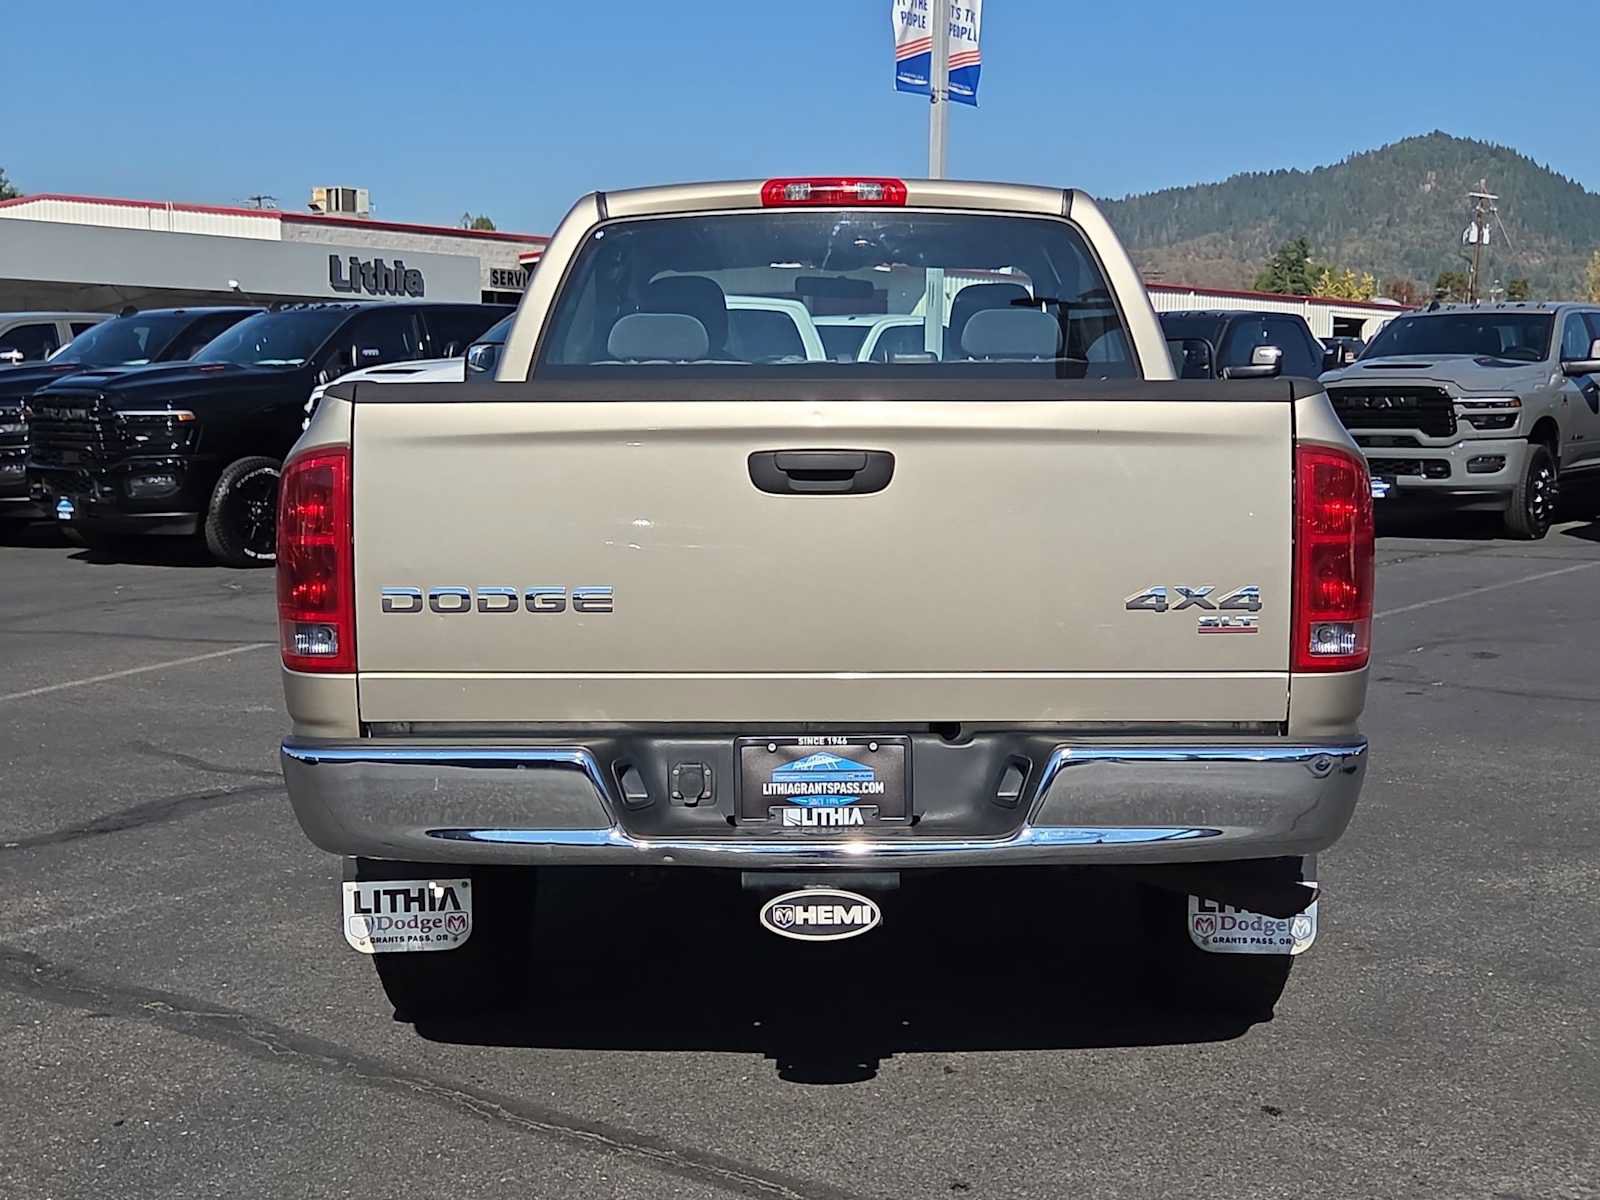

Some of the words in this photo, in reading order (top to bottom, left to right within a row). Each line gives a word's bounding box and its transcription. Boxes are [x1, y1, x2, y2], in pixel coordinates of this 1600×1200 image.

[329, 254, 425, 297] Lithia
[492, 269, 529, 287] SERVI
[381, 586, 614, 613] DODGE
[1125, 585, 1263, 612] 4X4
[798, 736, 825, 745] SINCE
[827, 736, 848, 745] 1946
[762, 781, 885, 795] LITHIAGRANTSPASS.COM
[802, 808, 864, 825] LITHIA
[353, 887, 461, 914] LITHIA
[377, 915, 443, 933] Dodge
[795, 905, 871, 925] HEMI
[1221, 915, 1287, 936] Dodge
[371, 935, 405, 944] GRANTS
[1212, 936, 1248, 945] GRANTS
